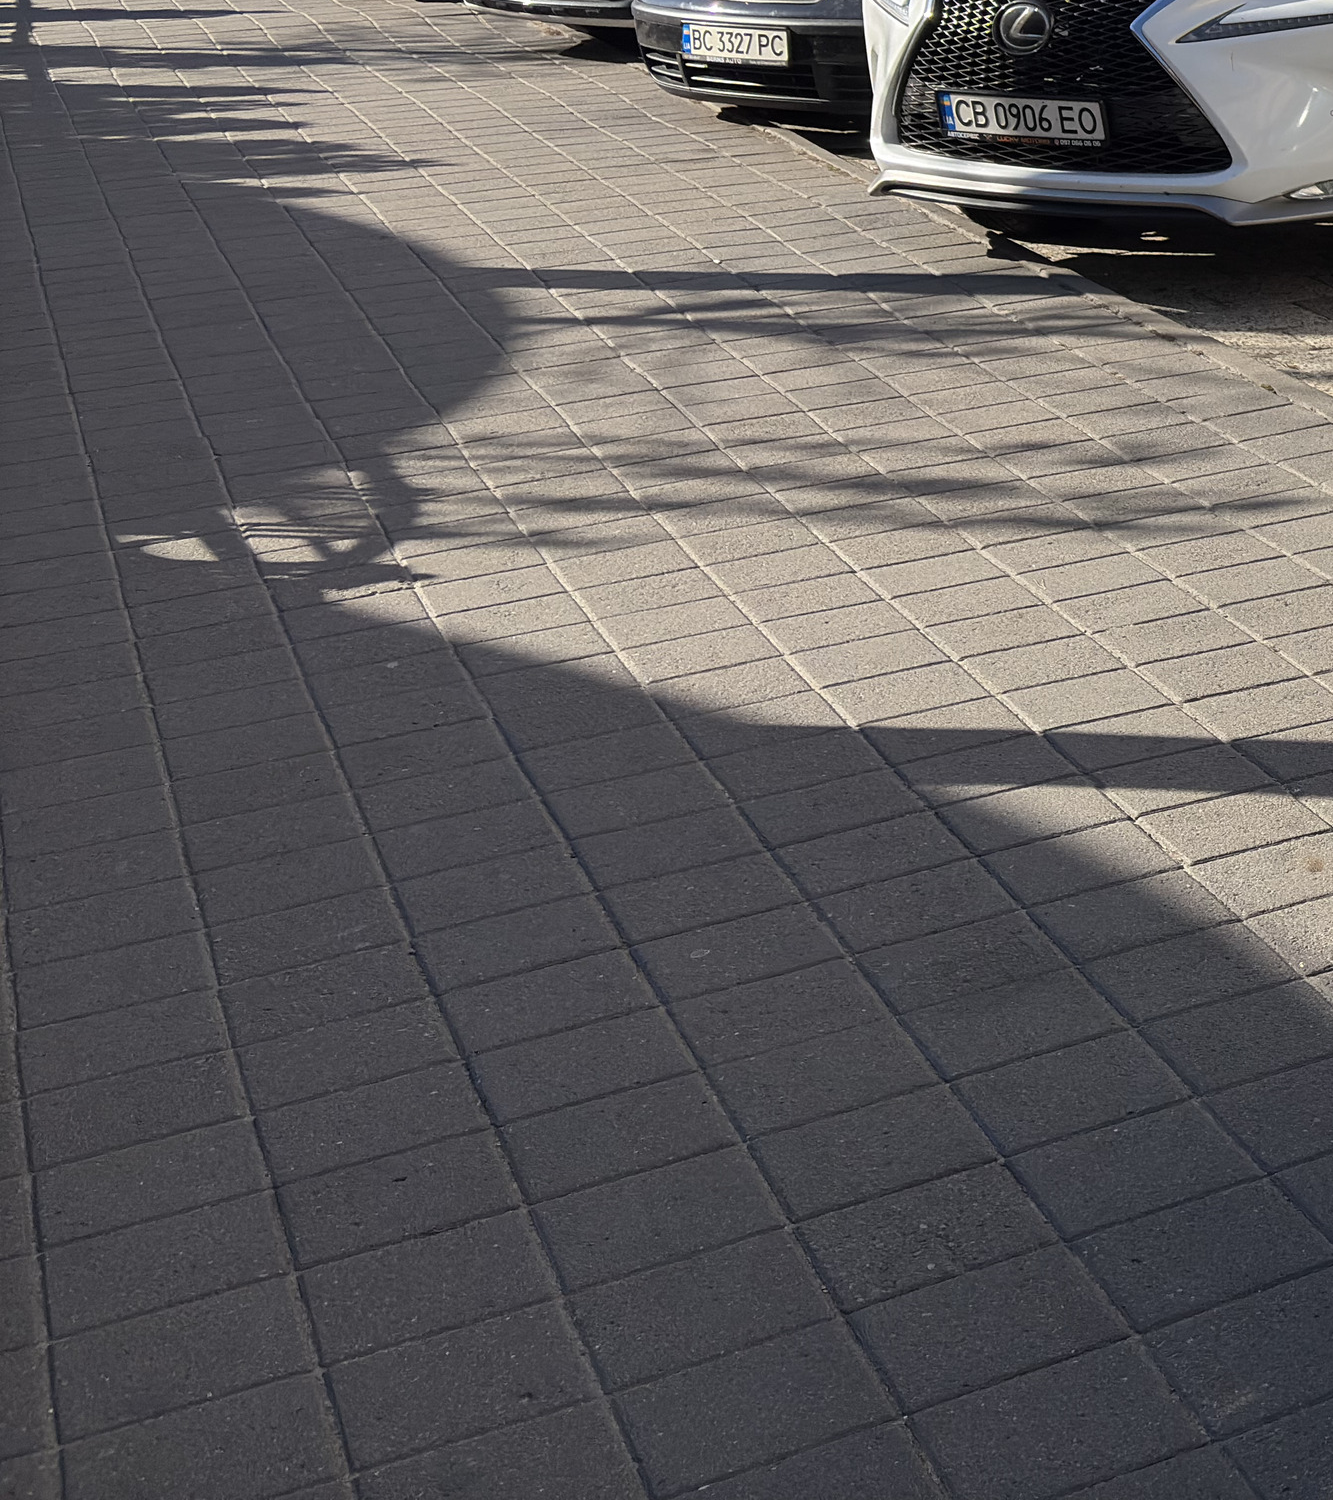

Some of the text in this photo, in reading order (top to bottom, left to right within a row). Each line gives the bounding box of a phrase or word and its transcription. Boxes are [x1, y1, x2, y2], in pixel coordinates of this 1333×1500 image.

[692, 29, 783, 56] BC 3327 PC
[955, 99, 1097, 135] CB 0906 EO
